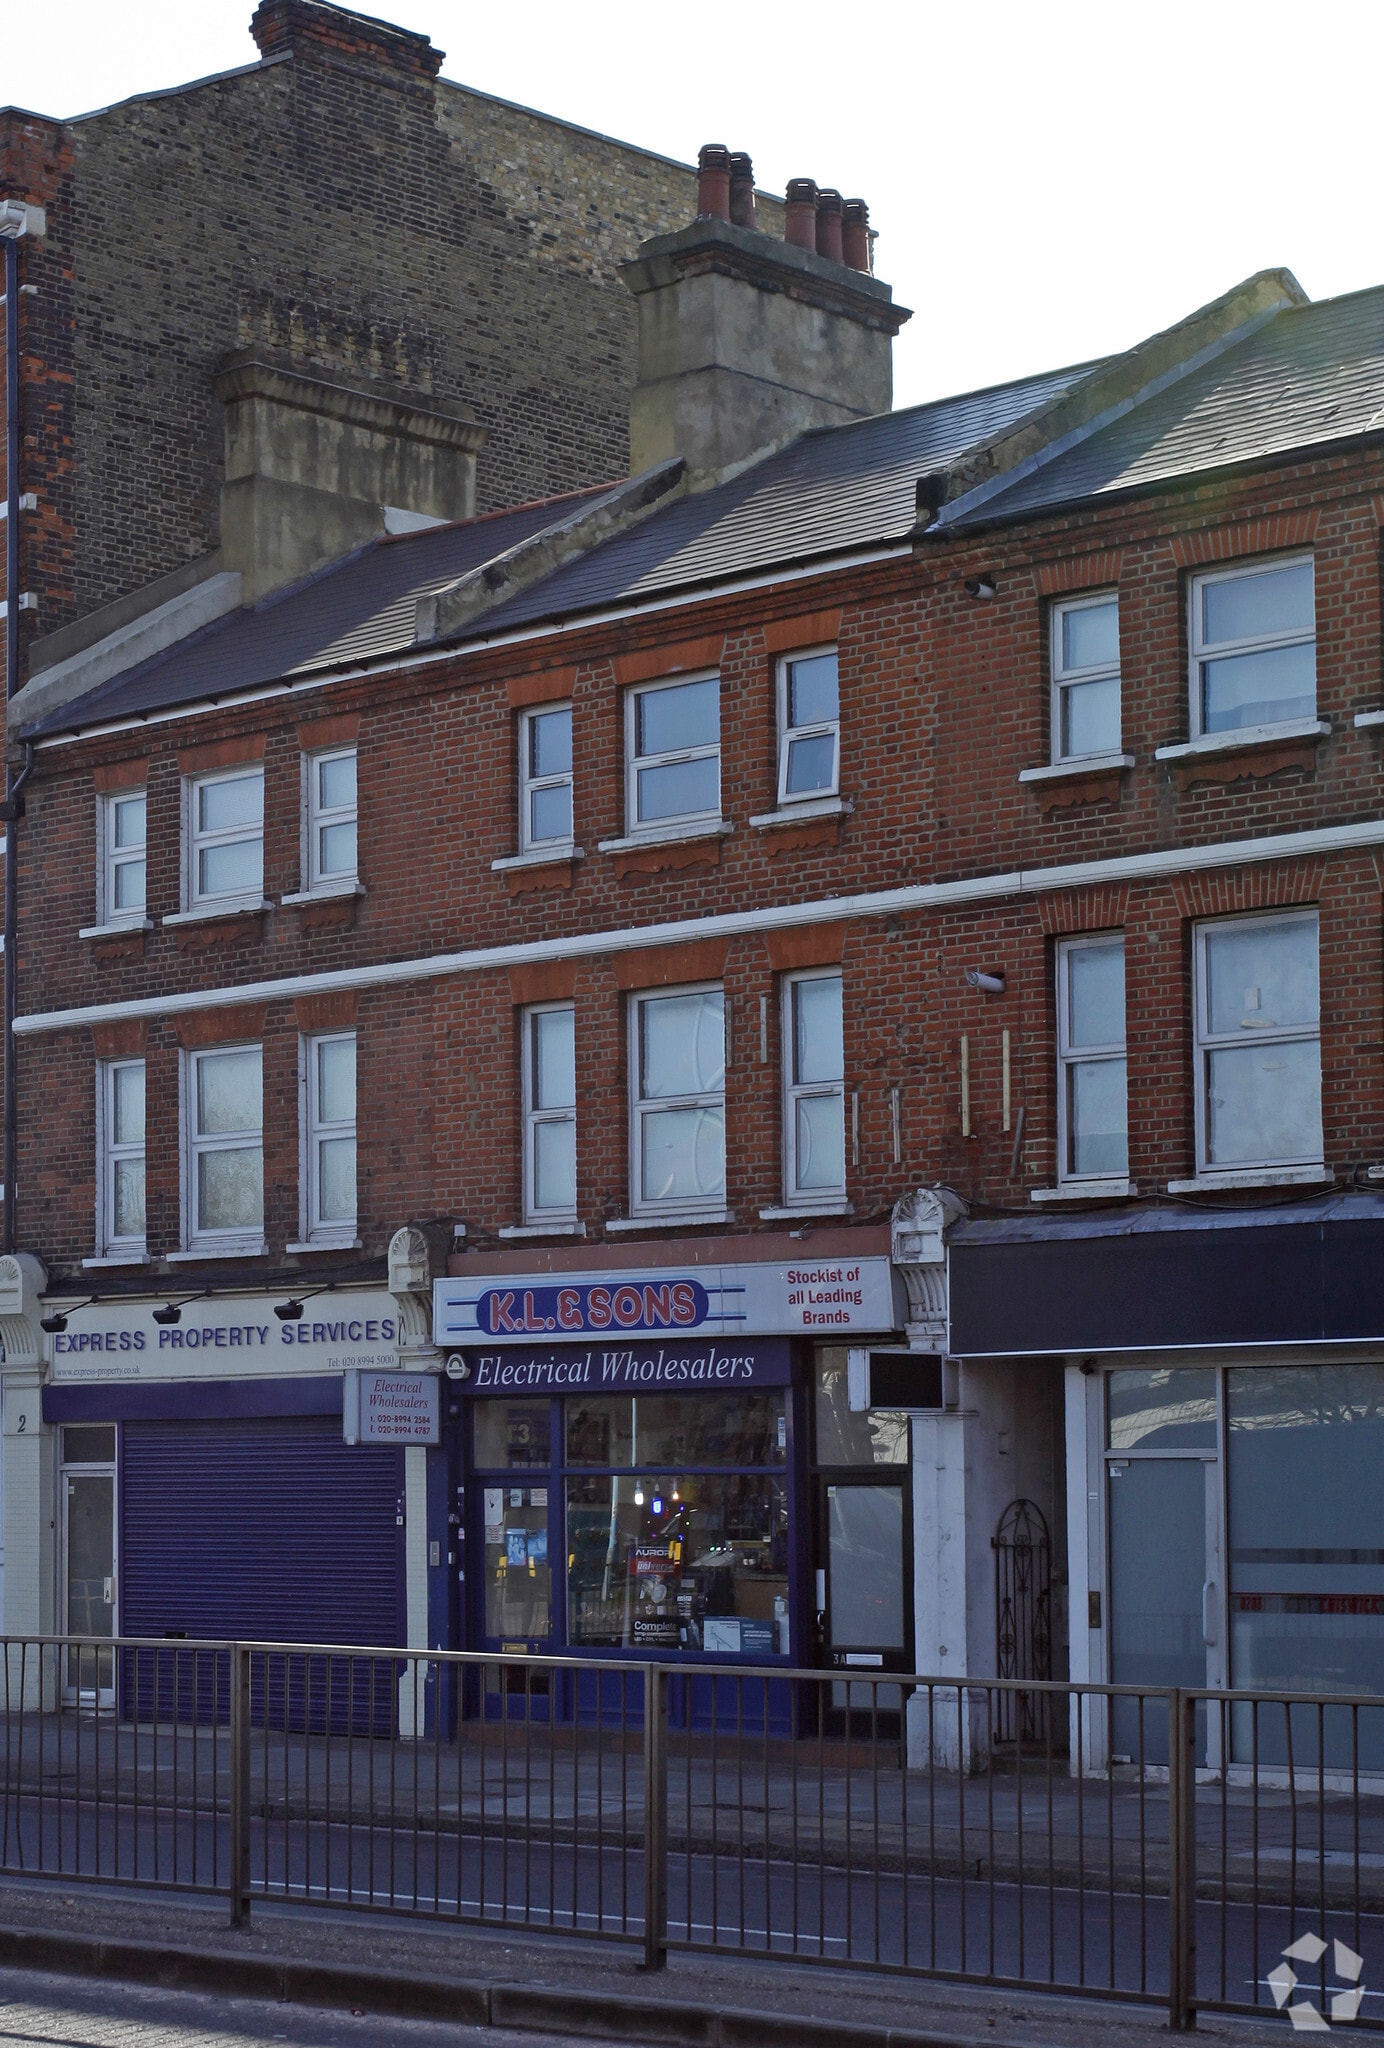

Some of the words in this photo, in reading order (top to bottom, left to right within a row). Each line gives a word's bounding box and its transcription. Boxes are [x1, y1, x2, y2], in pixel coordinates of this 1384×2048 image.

[787, 1267, 842, 1284] Stockist
[846, 1266, 860, 1282] of
[587, 1283, 696, 1328] SONS
[788, 1290, 805, 1305] all
[807, 1289, 862, 1306] Leading
[802, 1309, 850, 1325] Brands
[55, 1330, 146, 1353] EXPRESS
[158, 1325, 269, 1349] PROPERTY
[281, 1318, 396, 1345] SERVICES
[327, 1357, 340, 1367] Tel:
[342, 1356, 355, 1366] 020
[357, 1355, 374, 1365] 8994
[376, 1354, 394, 1365] 5000
[474, 1352, 592, 1386] Electrical
[601, 1348, 755, 1382] Wholesalers
[56, 1365, 141, 1377] www.express-property.co.uk
[374, 1379, 423, 1393] Electrical
[369, 1394, 428, 1409] Wholesalers
[17, 1415, 26, 1433] 2
[377, 1415, 411, 1424] 020-8994
[414, 1416, 431, 1424] 2584
[377, 1425, 411, 1435] 020-8994
[414, 1426, 431, 1435] 4787
